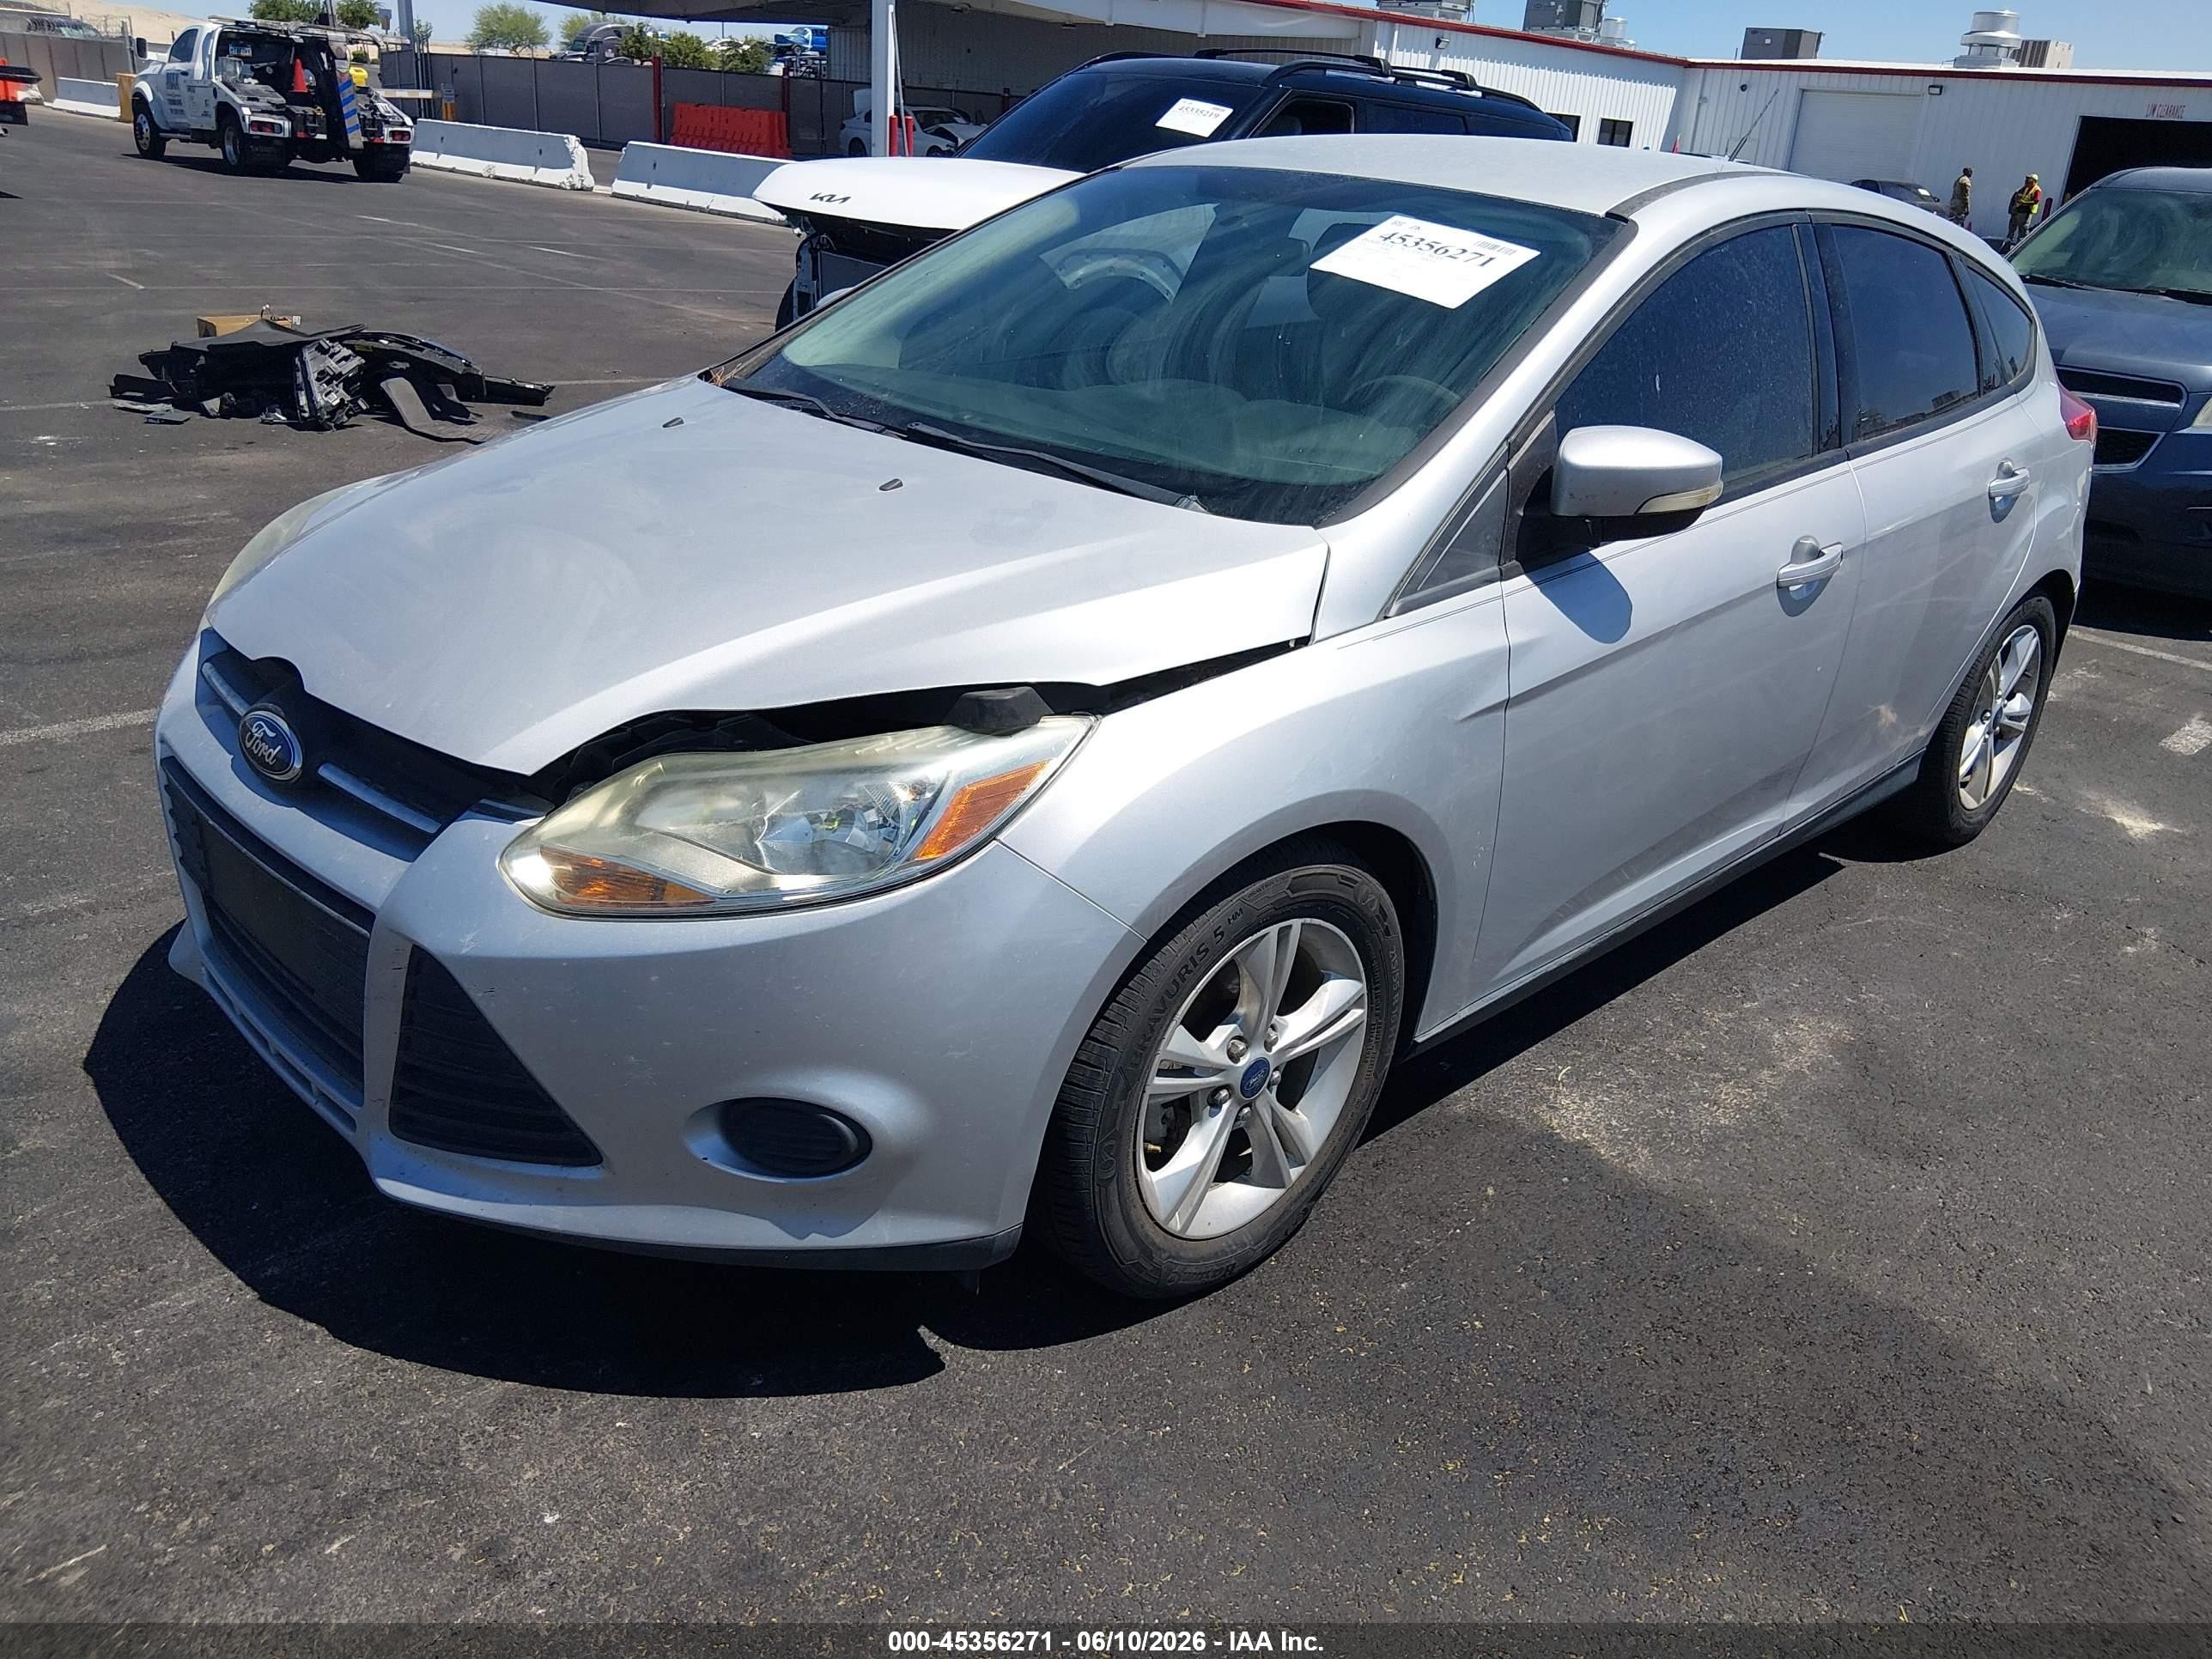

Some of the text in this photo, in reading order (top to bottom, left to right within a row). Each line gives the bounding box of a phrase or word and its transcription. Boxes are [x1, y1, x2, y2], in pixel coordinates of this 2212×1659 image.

[1378, 231, 1498, 267] 45356271
[245, 720, 282, 766] Ford
[1212, 924, 1225, 947] 5
[1226, 906, 1244, 926] HM
